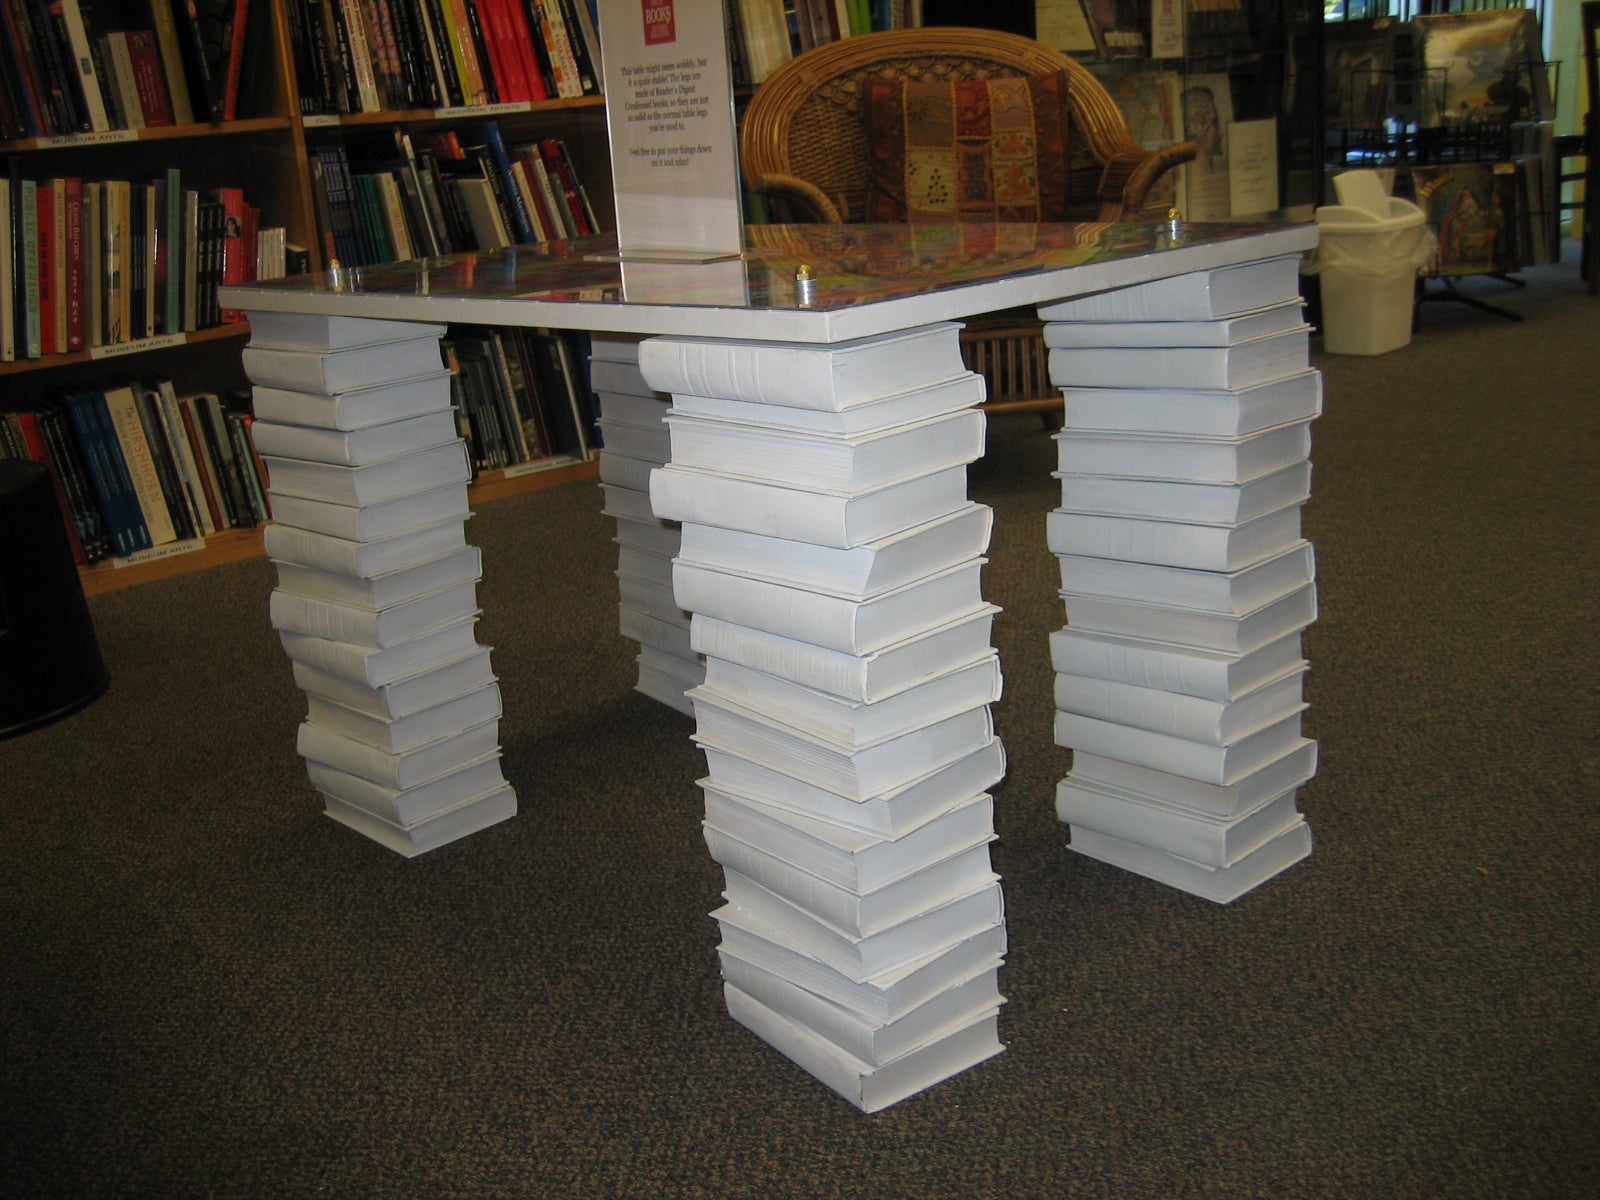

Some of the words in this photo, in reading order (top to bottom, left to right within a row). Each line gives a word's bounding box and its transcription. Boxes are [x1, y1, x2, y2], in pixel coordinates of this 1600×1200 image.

[645, 6, 672, 25] BOOKS
[633, 63, 645, 74] table
[645, 62, 661, 74] might
[662, 63, 675, 71] seem
[697, 58, 707, 67] but
[670, 73, 680, 82] The
[681, 72, 691, 82] legs
[635, 89, 648, 98] made
[679, 85, 695, 95] Digest
[677, 97, 688, 107] they
[690, 98, 699, 106] are
[699, 96, 708, 105] not
[654, 111, 662, 119] the
[663, 110, 681, 119] normal
[682, 108, 696, 117] table
[697, 107, 707, 119] legs
[51, 135, 97, 145] MUSEUM
[98, 133, 125, 141] ARTS
[641, 146, 650, 156] free
[657, 146, 666, 157] put
[667, 147, 678, 156] your
[679, 144, 696, 155] things
[697, 143, 712, 153] down
[664, 157, 674, 166] and
[25, 185, 37, 235] PUBLIC
[27, 240, 39, 313] OFFERINGS
[104, 343, 148, 355] MUSEUM
[149, 339, 174, 348] ARTS
[130, 420, 162, 505] HIRSHHORN
[126, 550, 168, 563] MUSEUM
[169, 544, 194, 556] ARTS
